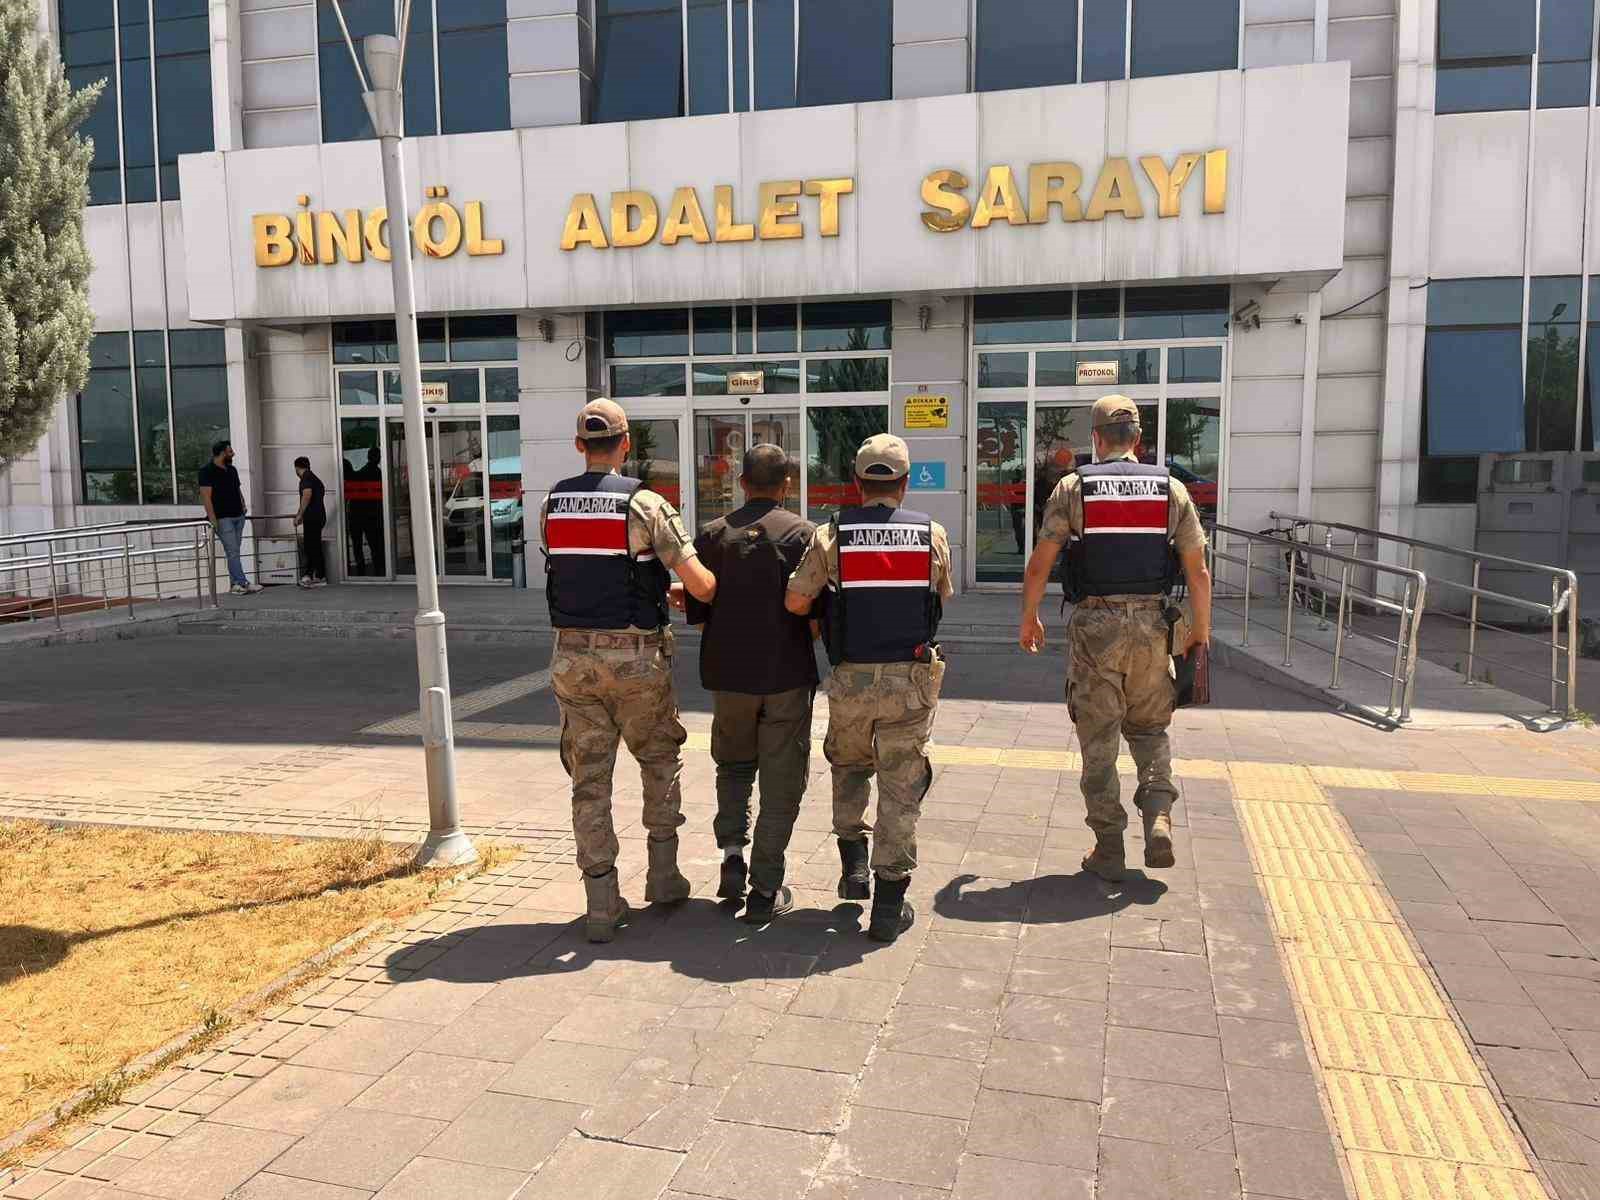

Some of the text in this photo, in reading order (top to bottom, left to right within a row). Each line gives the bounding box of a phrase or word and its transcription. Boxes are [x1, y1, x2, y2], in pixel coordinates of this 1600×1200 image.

[560, 177, 854, 250] ADALET
[921, 148, 1229, 233] SARAYI
[1079, 368, 1115, 376] PROTOKOL
[1093, 480, 1160, 496] JANDARMA
[553, 496, 617, 514] JANDARMA
[849, 528, 922, 547] JANDARMA
